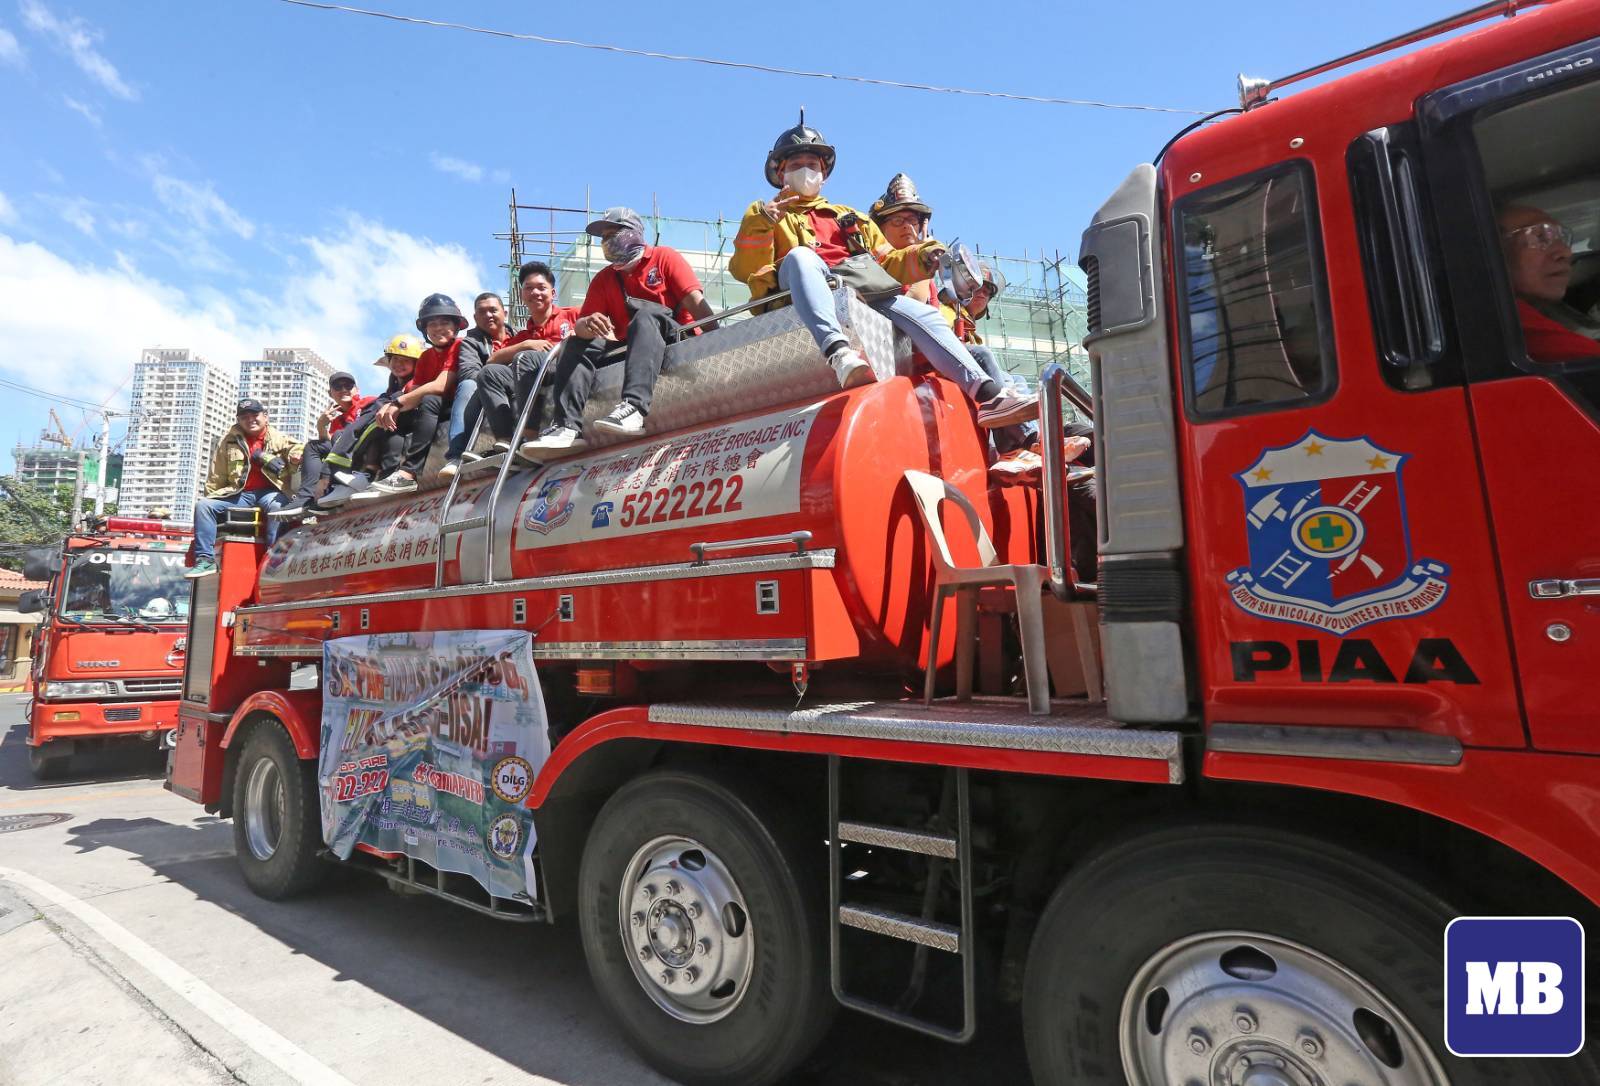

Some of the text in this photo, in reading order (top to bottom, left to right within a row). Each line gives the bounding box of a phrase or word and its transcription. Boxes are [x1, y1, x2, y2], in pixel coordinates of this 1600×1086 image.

[1526, 57, 1594, 82] HINO
[698, 436, 727, 456] FIRE
[724, 424, 782, 452] BRIGADE
[780, 419, 805, 440] INC.
[619, 474, 744, 528] 5222222
[1233, 581, 1445, 630] SOUTH SAN NICOLAS VOLUNTEER FIRE BRIGADE
[1230, 638, 1481, 685] PIAA
[359, 755, 387, 768] FIRE
[502, 775, 525, 786] DILG
